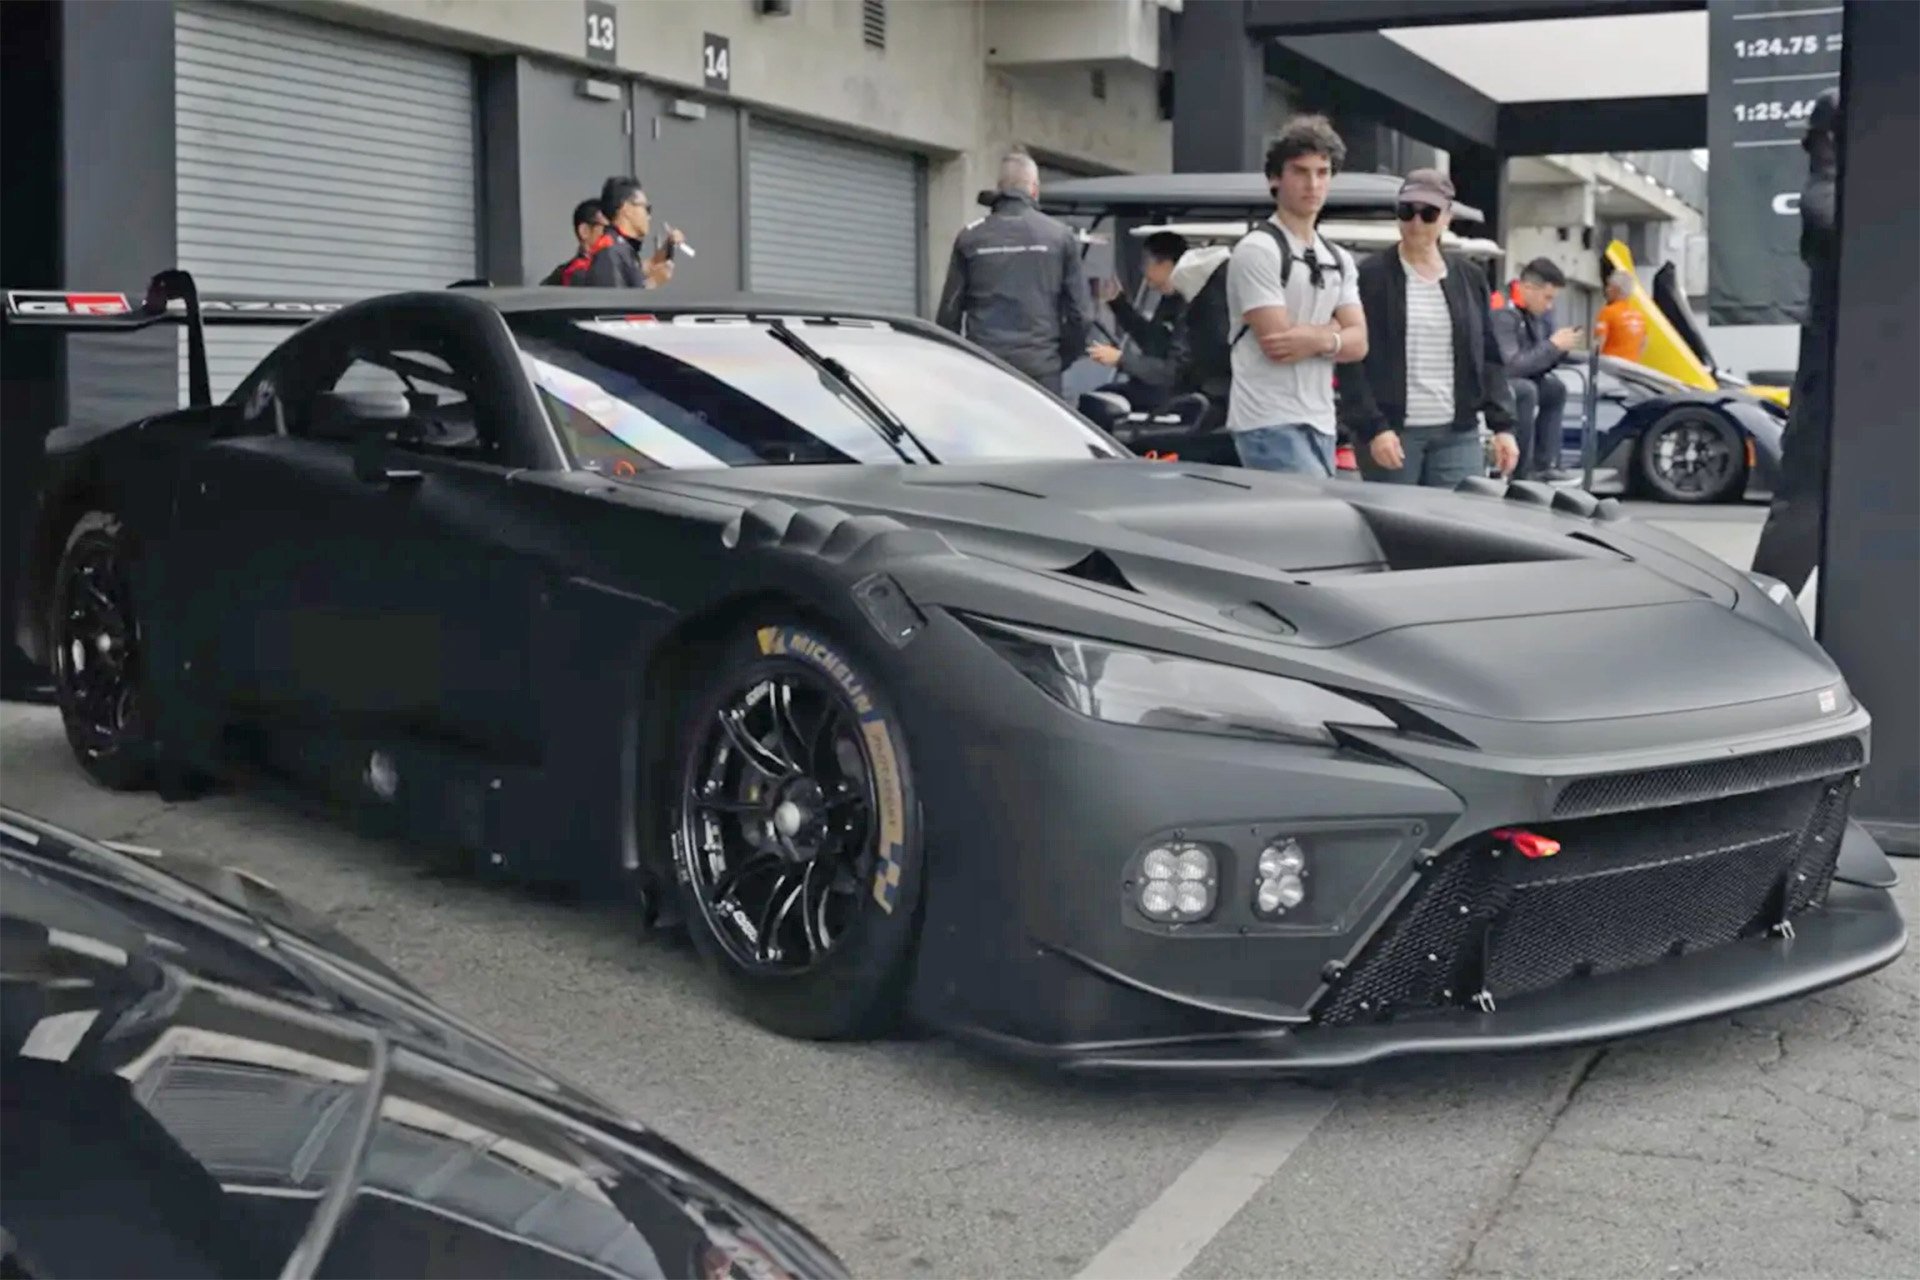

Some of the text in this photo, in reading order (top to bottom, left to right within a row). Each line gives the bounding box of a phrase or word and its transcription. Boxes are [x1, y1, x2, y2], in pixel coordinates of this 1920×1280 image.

[588, 14, 614, 50] 13
[1734, 35, 1818, 58] 1:24.75
[705, 46, 728, 80] 14
[790, 634, 872, 713] MICHELIN
